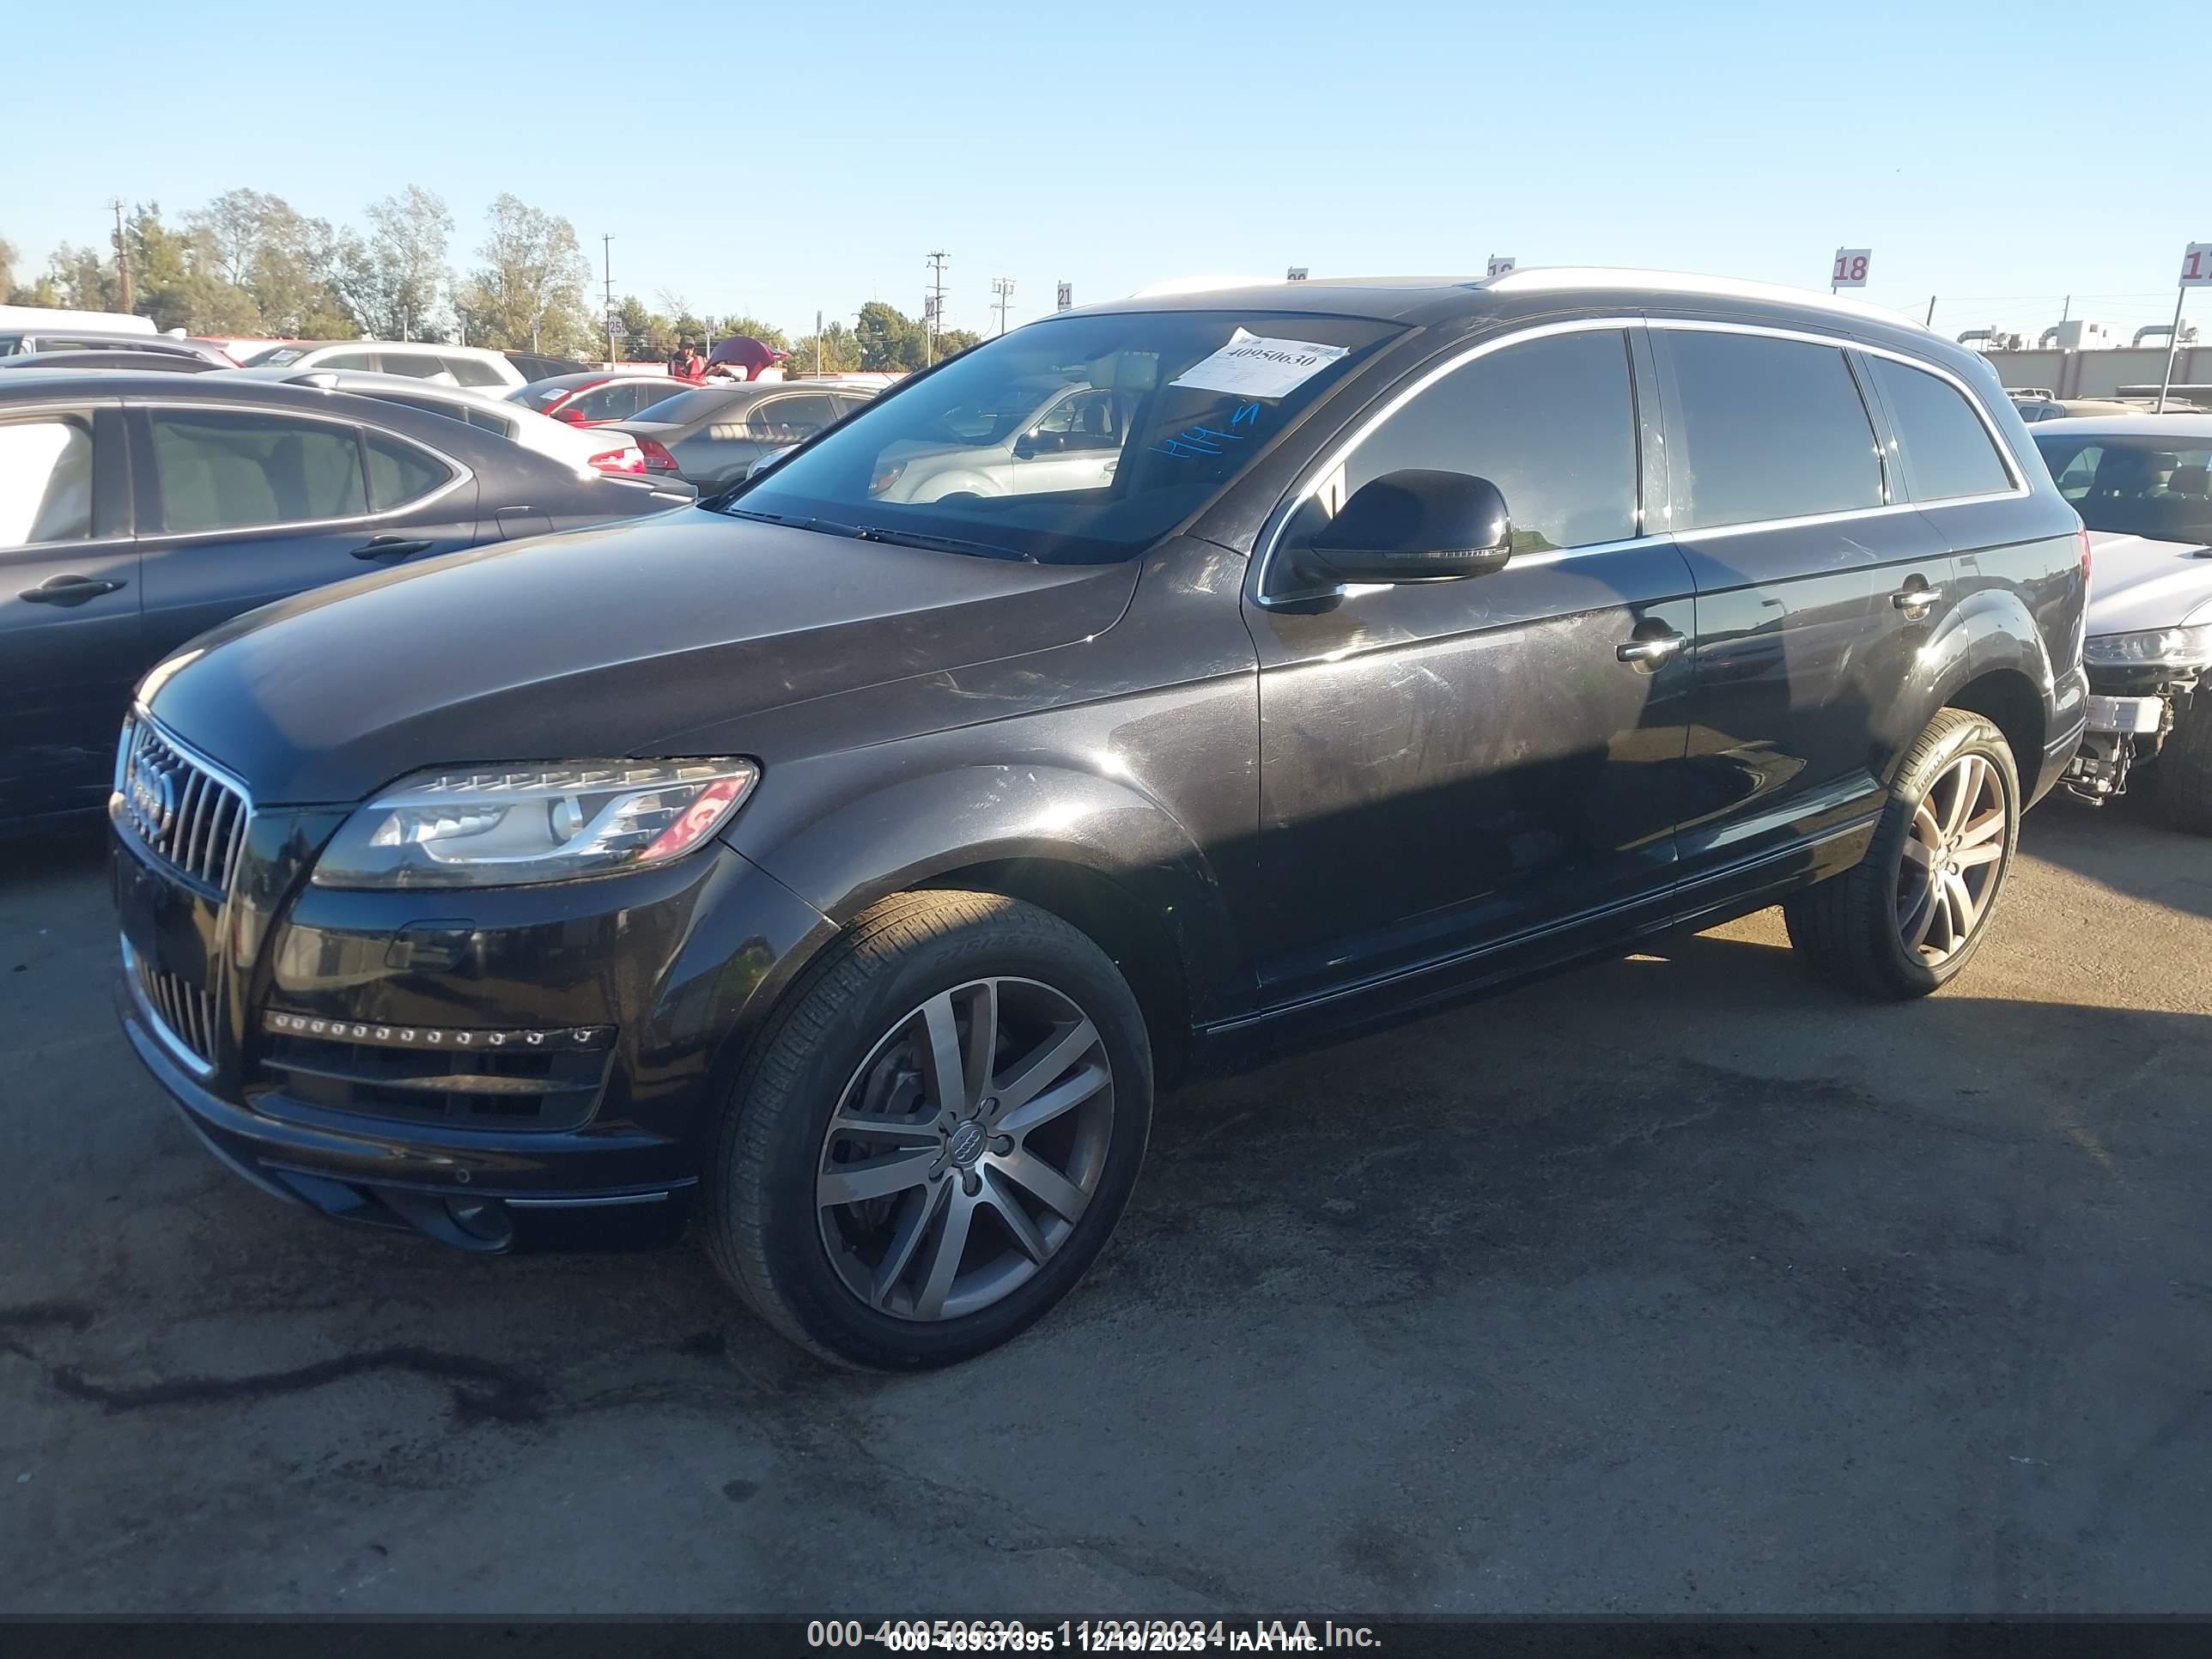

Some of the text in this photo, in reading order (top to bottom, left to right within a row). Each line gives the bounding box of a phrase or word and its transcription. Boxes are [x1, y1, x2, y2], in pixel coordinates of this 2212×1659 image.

[1834, 256, 1868, 281] 18
[2183, 252, 2212, 279] 1
[1058, 288, 1072, 306] 21
[926, 301, 935, 318] 22
[610, 321, 622, 333] 25
[1227, 347, 1317, 368] 40950630
